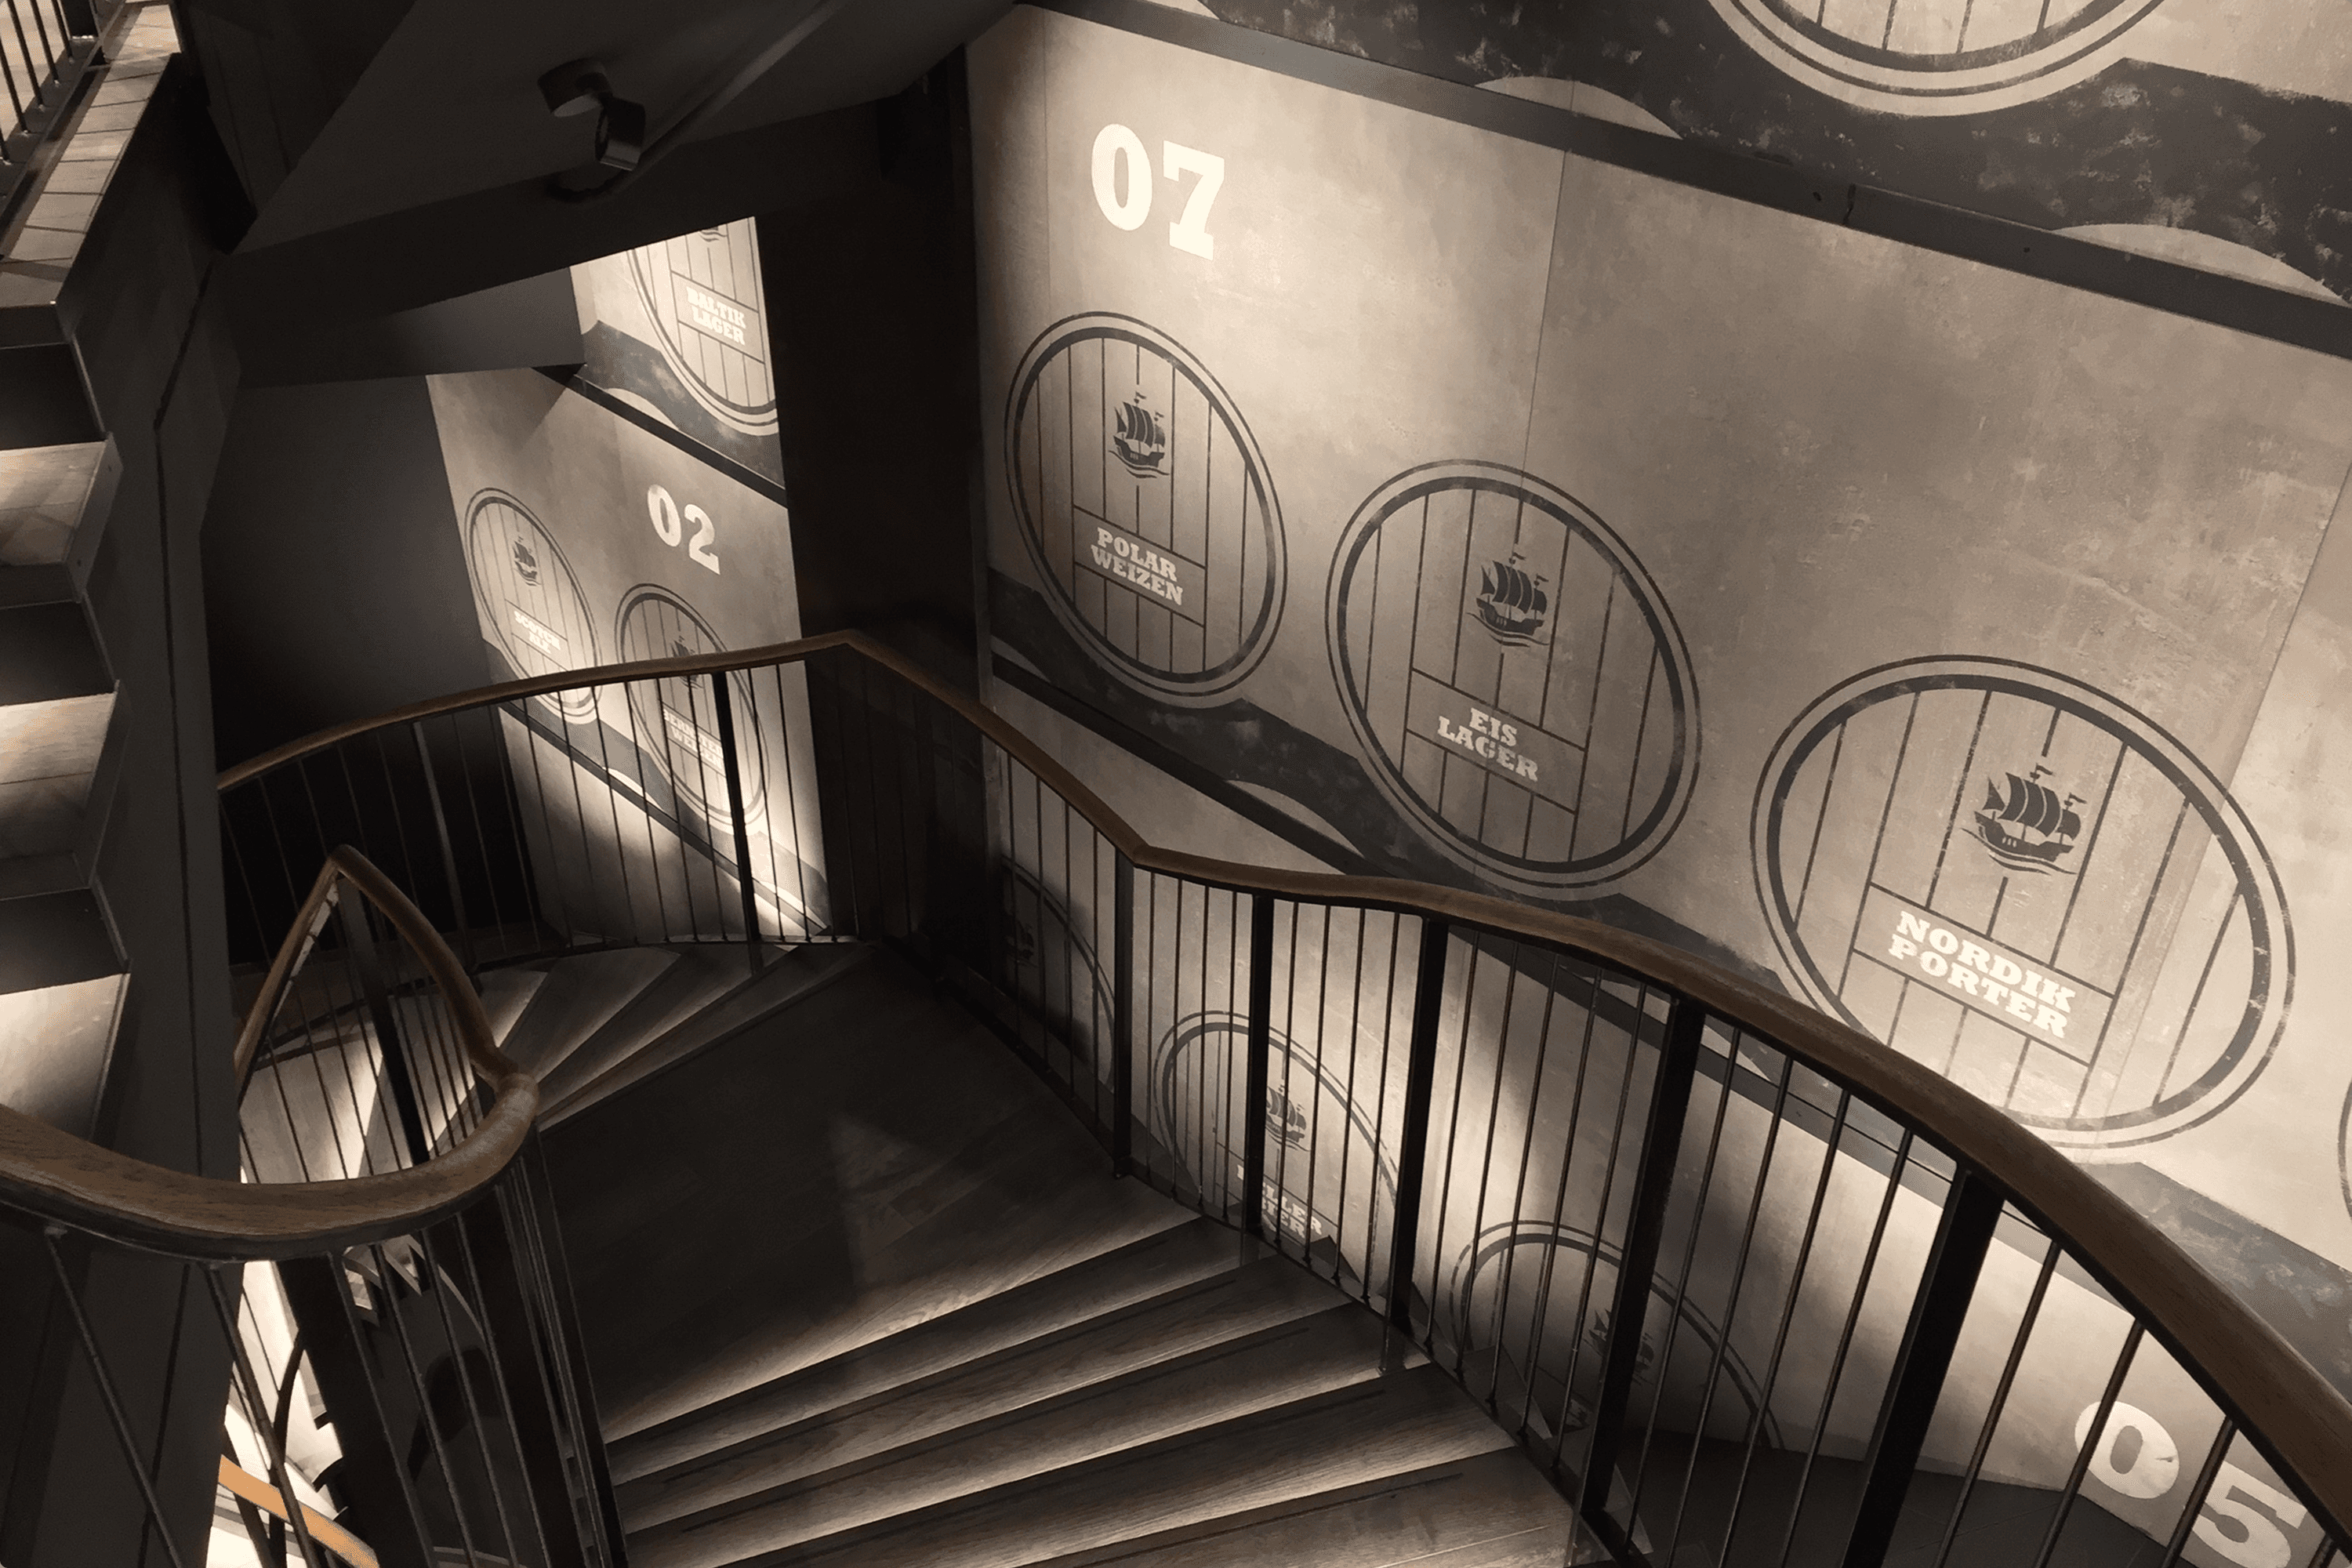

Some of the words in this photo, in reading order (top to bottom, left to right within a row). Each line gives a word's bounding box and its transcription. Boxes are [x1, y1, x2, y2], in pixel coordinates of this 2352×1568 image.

[1091, 123, 1225, 261] 07
[687, 286, 746, 329] BALTIK
[691, 305, 746, 346] LAGER
[647, 484, 720, 575] 02
[1098, 527, 1178, 583] POLAR
[1091, 544, 1183, 606] WEIZEN
[514, 611, 561, 651] SCOTCH
[1437, 716, 1539, 782] LAGER
[1469, 707, 1518, 746] EIS
[1888, 934, 2068, 1039] PORTER
[1896, 910, 2076, 1014] NORDIK
[2074, 1400, 2307, 1568] 05
